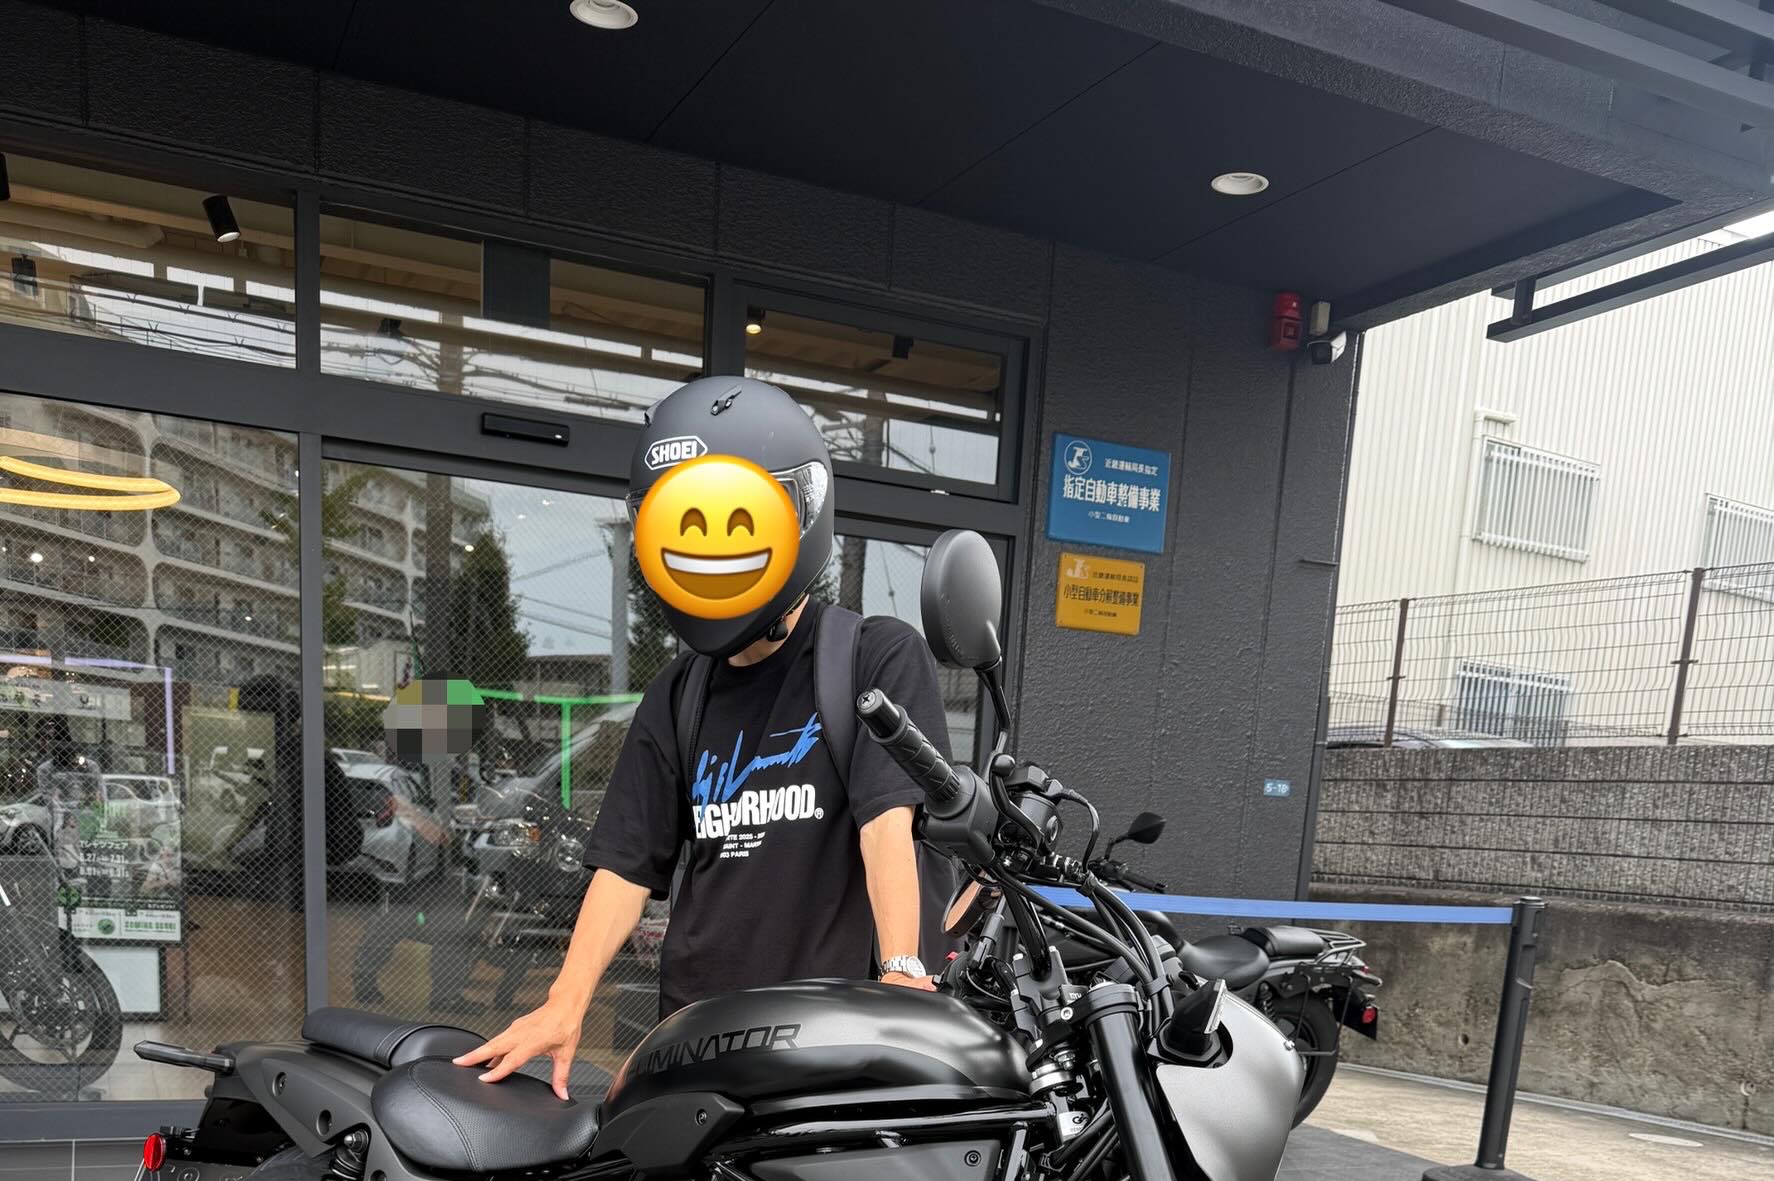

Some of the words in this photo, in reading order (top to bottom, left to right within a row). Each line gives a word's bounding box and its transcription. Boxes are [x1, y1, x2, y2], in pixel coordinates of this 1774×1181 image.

[651, 440, 698, 465] SHOEI
[1063, 474, 1161, 512] 指定自動車整備事業
